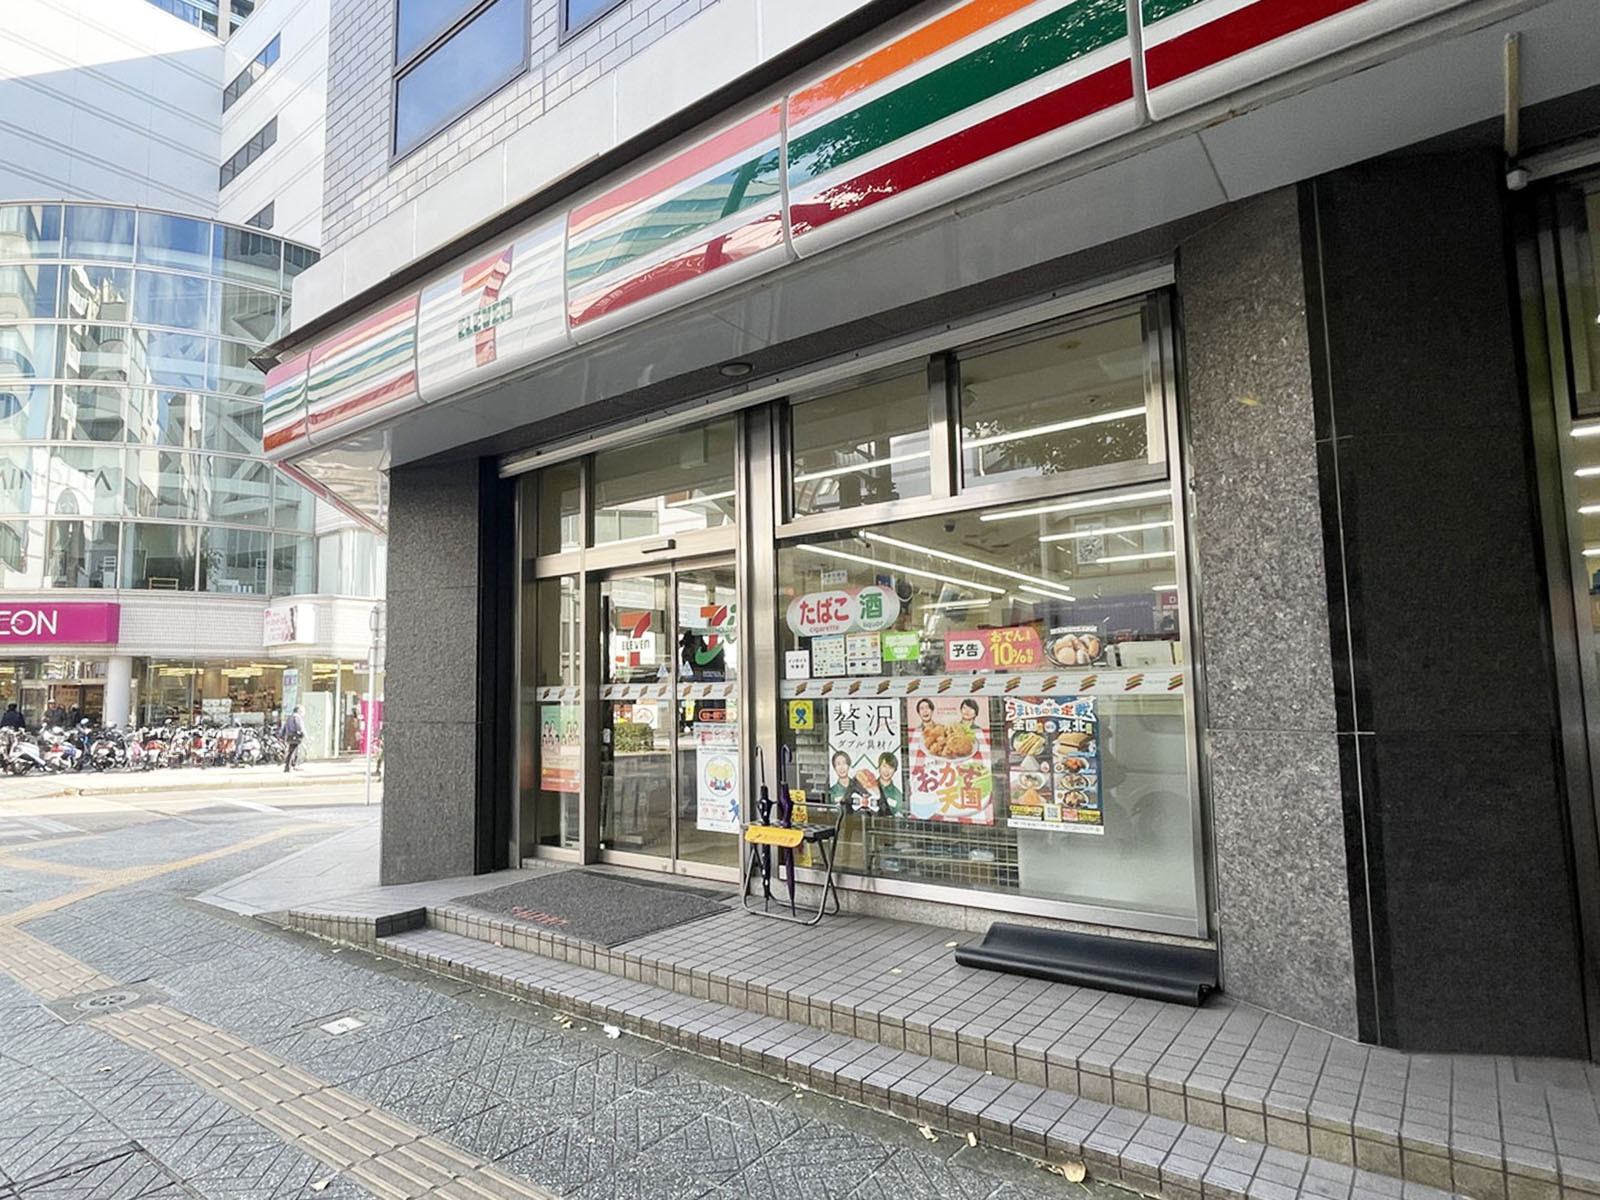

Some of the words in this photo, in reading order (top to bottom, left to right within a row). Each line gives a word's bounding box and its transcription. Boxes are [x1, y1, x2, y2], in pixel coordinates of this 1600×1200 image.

[800, 597, 849, 625] たばこ
[859, 592, 883, 620] 酒
[809, 625, 840, 634] cigarette
[952, 643, 979, 658] 予告
